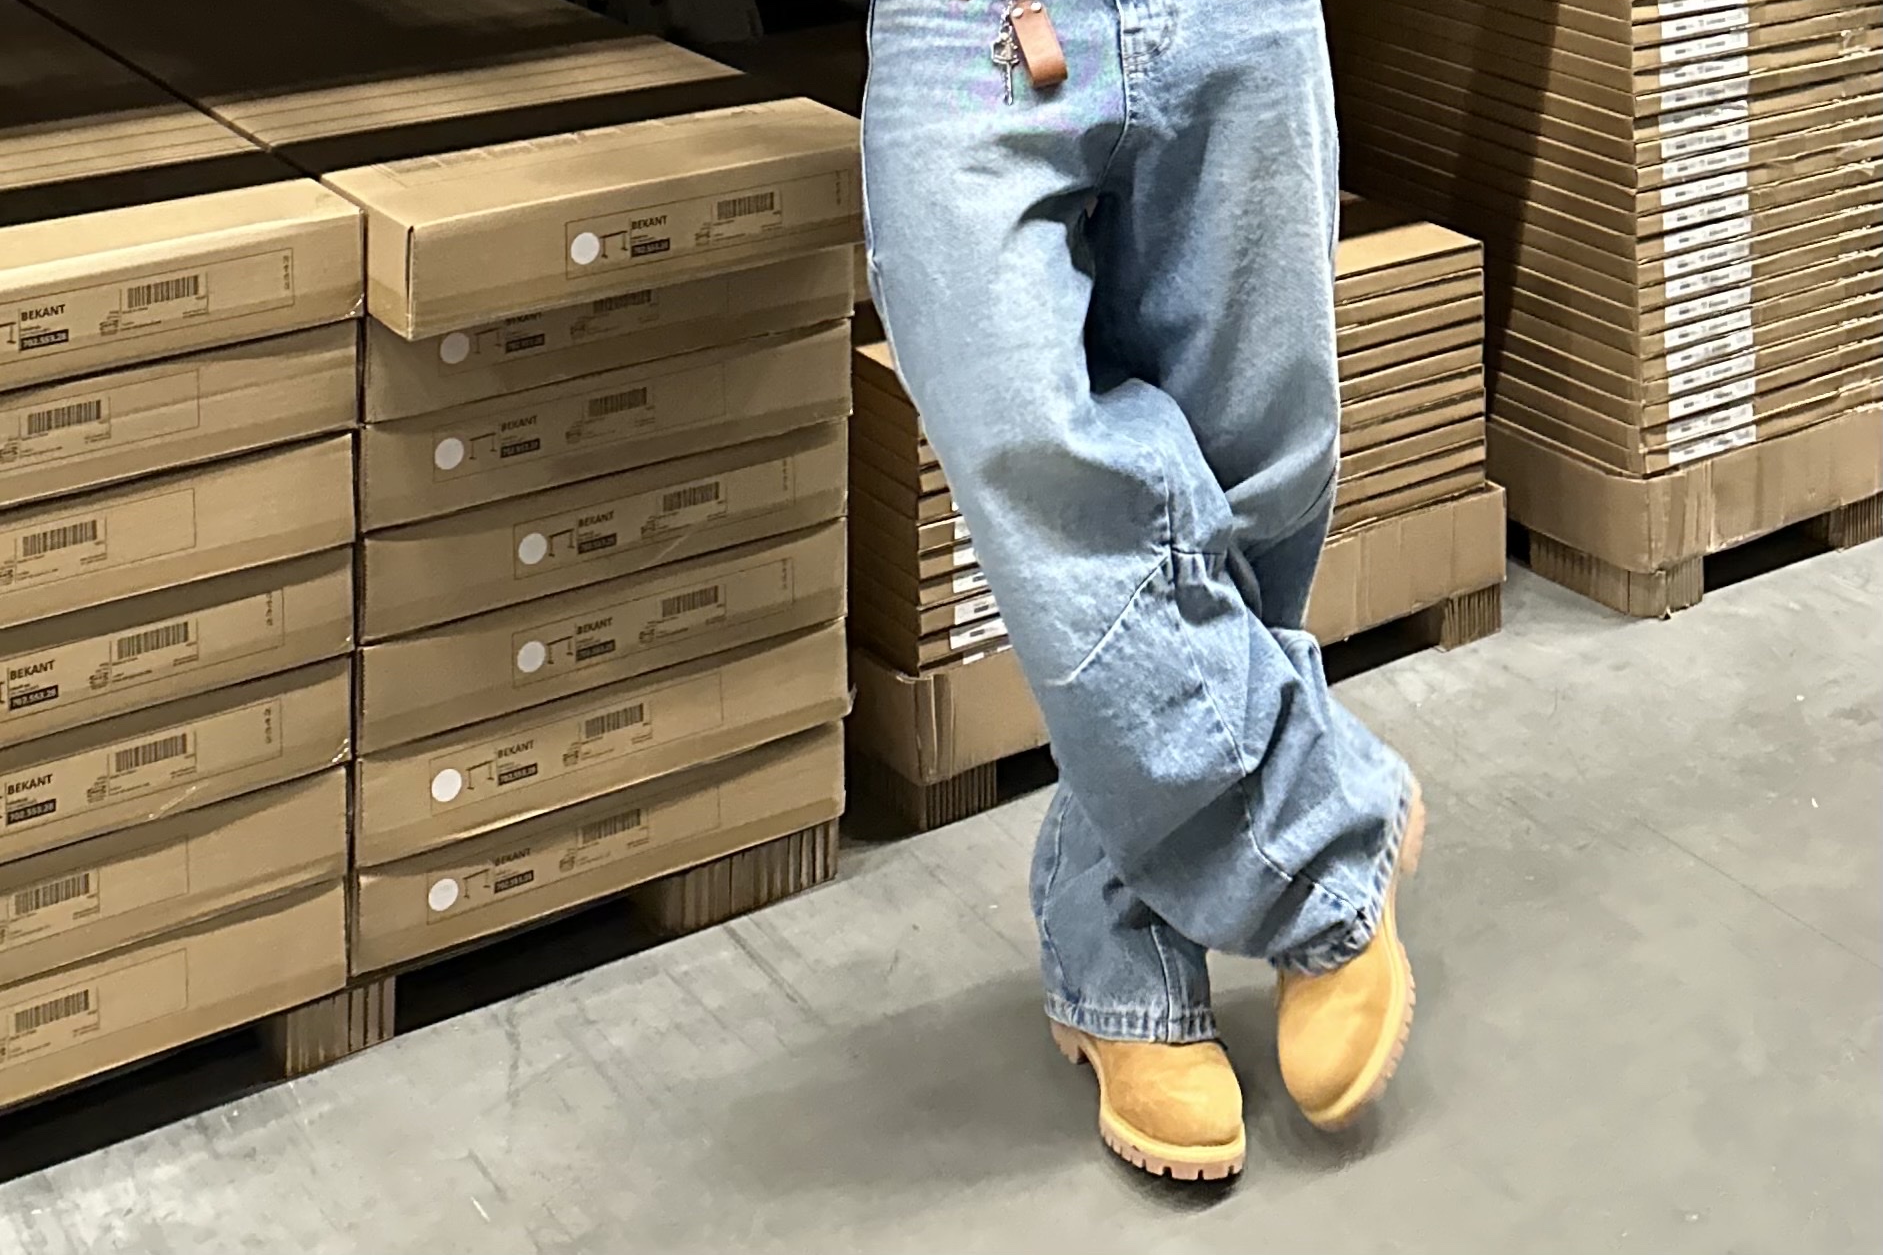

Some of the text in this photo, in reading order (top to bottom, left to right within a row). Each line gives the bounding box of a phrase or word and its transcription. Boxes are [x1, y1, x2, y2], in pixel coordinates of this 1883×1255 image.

[631, 215, 668, 230] BEKANT
[21, 304, 66, 322] BEKANT
[501, 415, 538, 432] BEKANT
[578, 510, 615, 528] BEKANT
[577, 617, 613, 635] BEKANT
[10, 659, 56, 681] BEKANT
[497, 739, 535, 758] BEKANT
[7, 773, 54, 795] BEKANT
[494, 848, 531, 867] BEKANT
